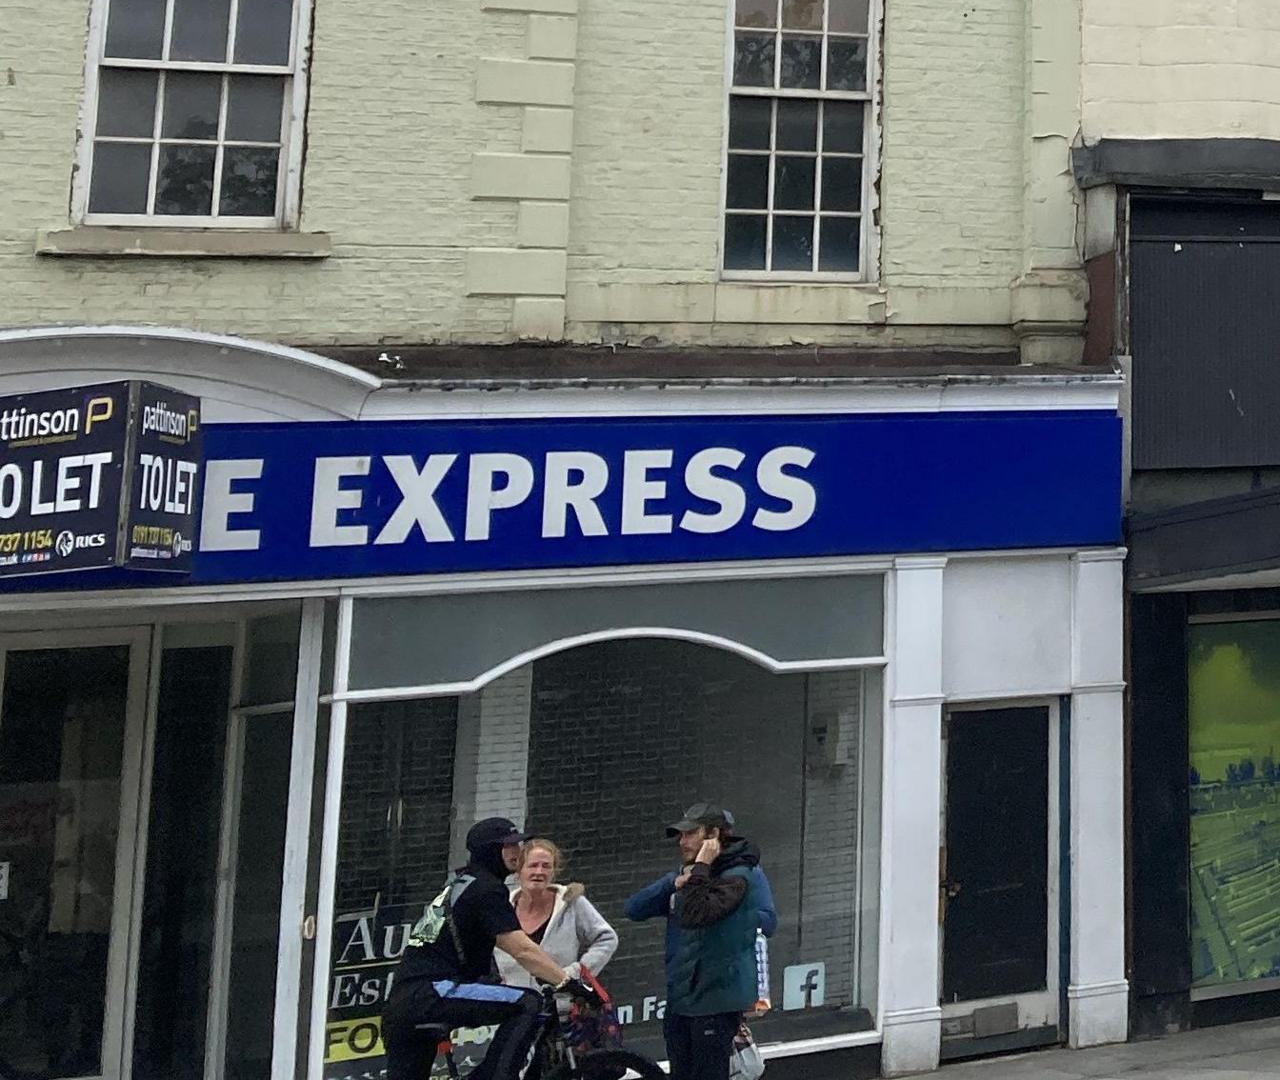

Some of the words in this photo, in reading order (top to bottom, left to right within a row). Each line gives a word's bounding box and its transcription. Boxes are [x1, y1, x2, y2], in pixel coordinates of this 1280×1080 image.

[0, 407, 79, 440] ttinson
[142, 401, 187, 437] pattinson
[0, 463, 22, 519] O
[30, 452, 113, 515] LET
[139, 453, 164, 511] TO
[164, 458, 197, 515] LET
[309, 445, 817, 548] EXPRESS
[75, 533, 106, 549] RICS
[336, 916, 412, 965] Au
